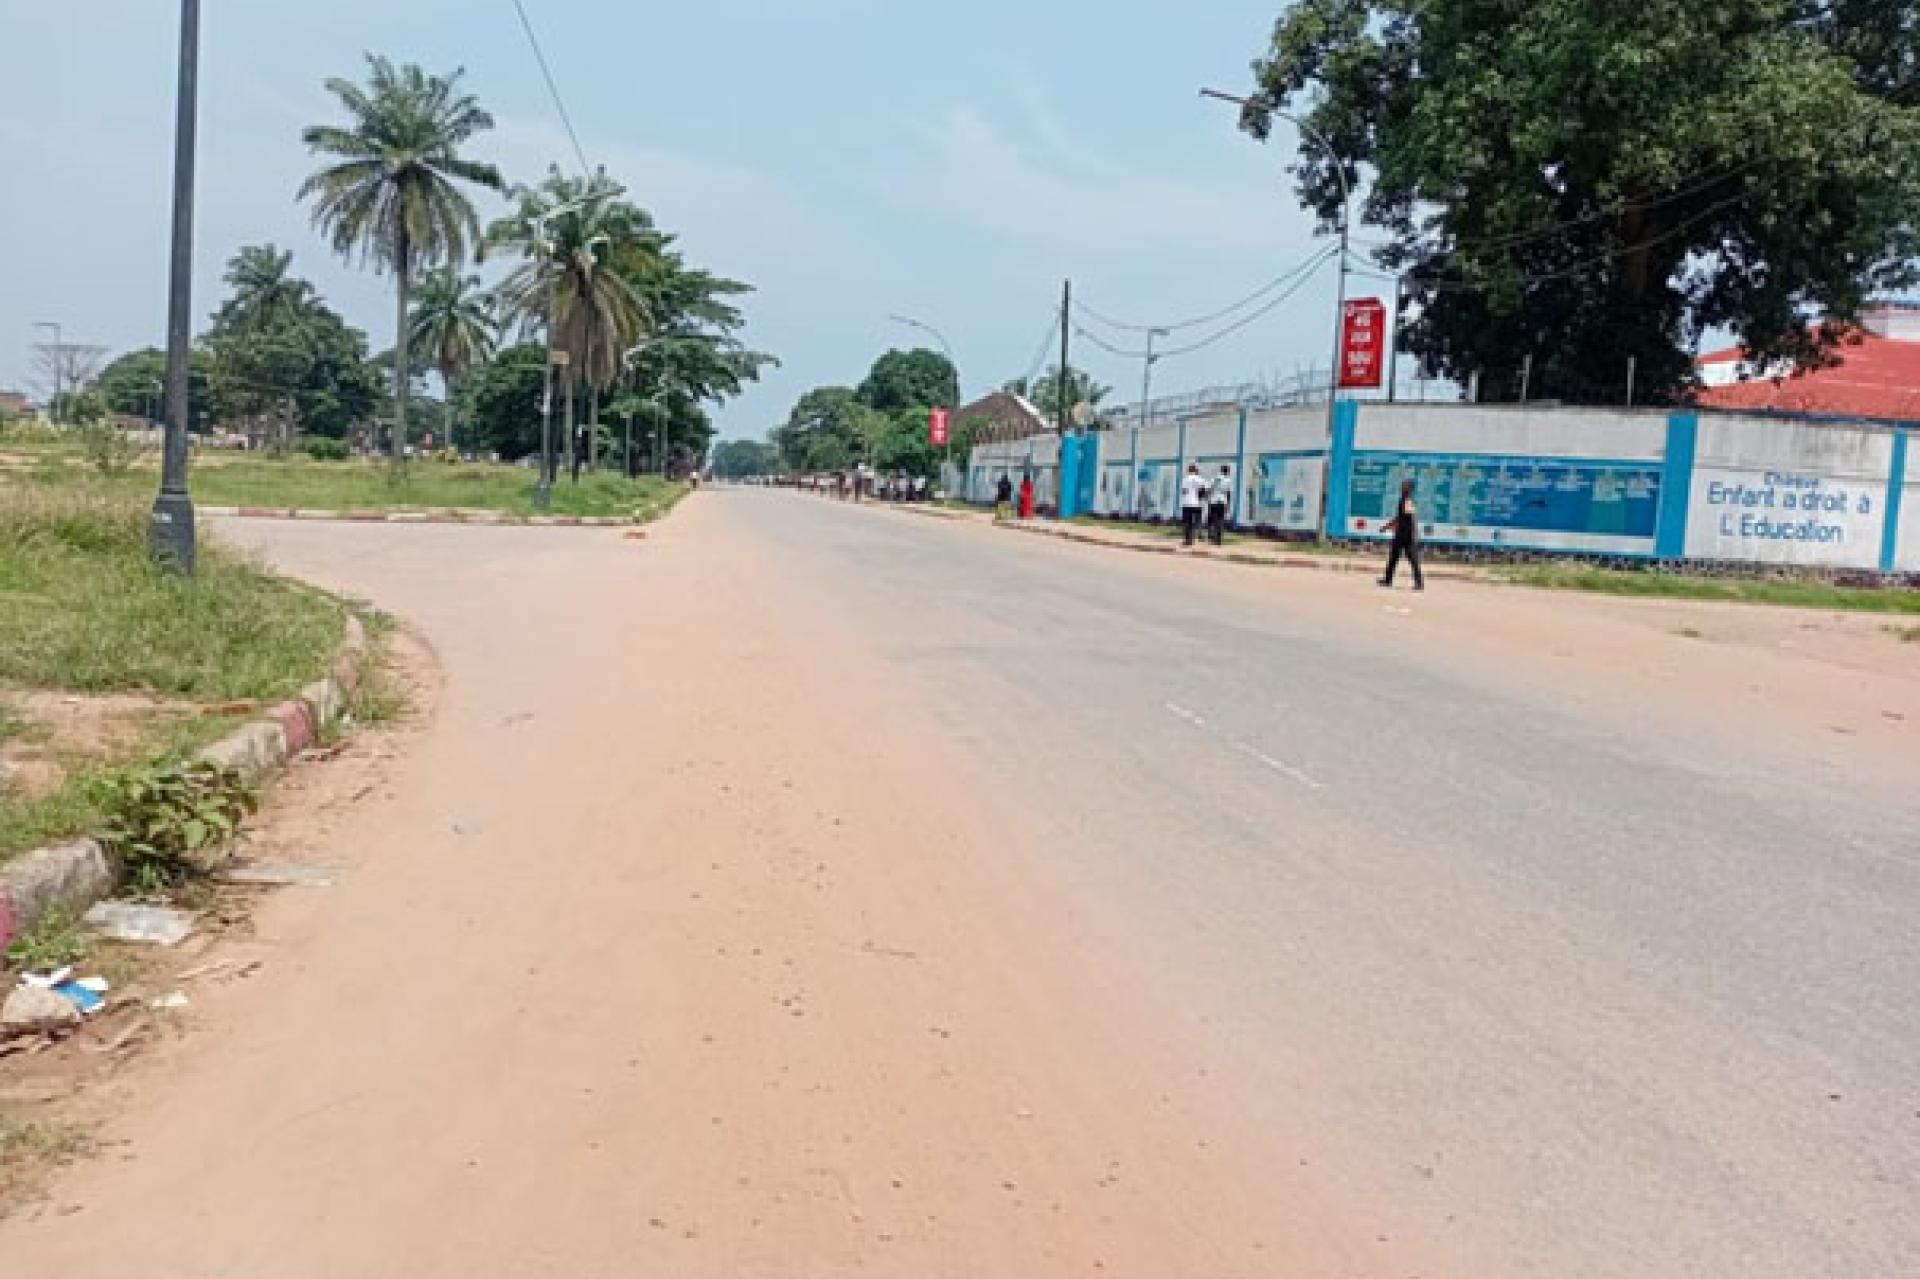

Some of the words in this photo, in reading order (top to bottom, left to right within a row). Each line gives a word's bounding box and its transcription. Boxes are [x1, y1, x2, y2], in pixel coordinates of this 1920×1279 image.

[1707, 481, 1775, 507] Enfant
[1783, 494, 1797, 509] a
[1801, 488, 1847, 511] droit
